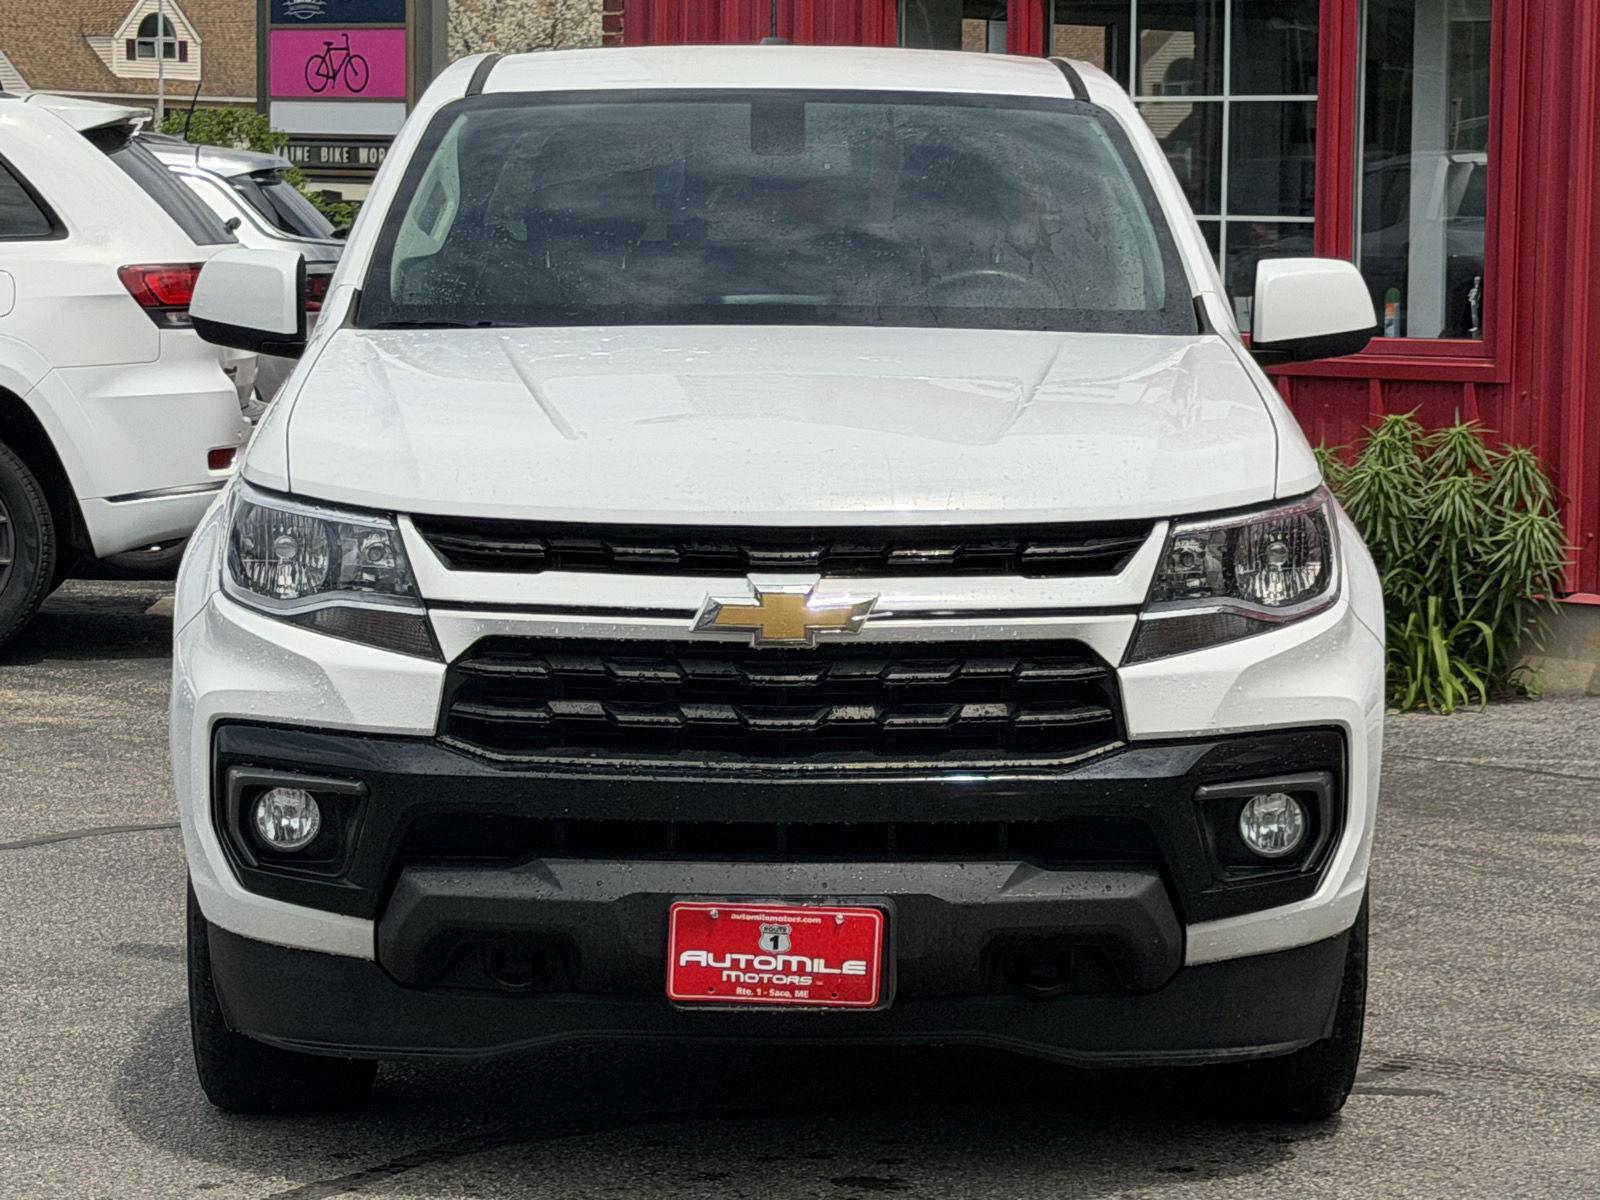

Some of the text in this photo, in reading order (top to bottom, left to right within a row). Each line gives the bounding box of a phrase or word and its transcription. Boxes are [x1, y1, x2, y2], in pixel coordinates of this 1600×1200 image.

[321, 147, 349, 163] BIKE
[731, 913, 822, 924] automilemotors.com
[769, 935, 779, 950] 1
[679, 950, 867, 975] AUTOMILE
[722, 970, 813, 986] MOTORS
[736, 987, 754, 996] Rte.
[769, 989, 792, 998] Saco,
[794, 990, 809, 998] ME
